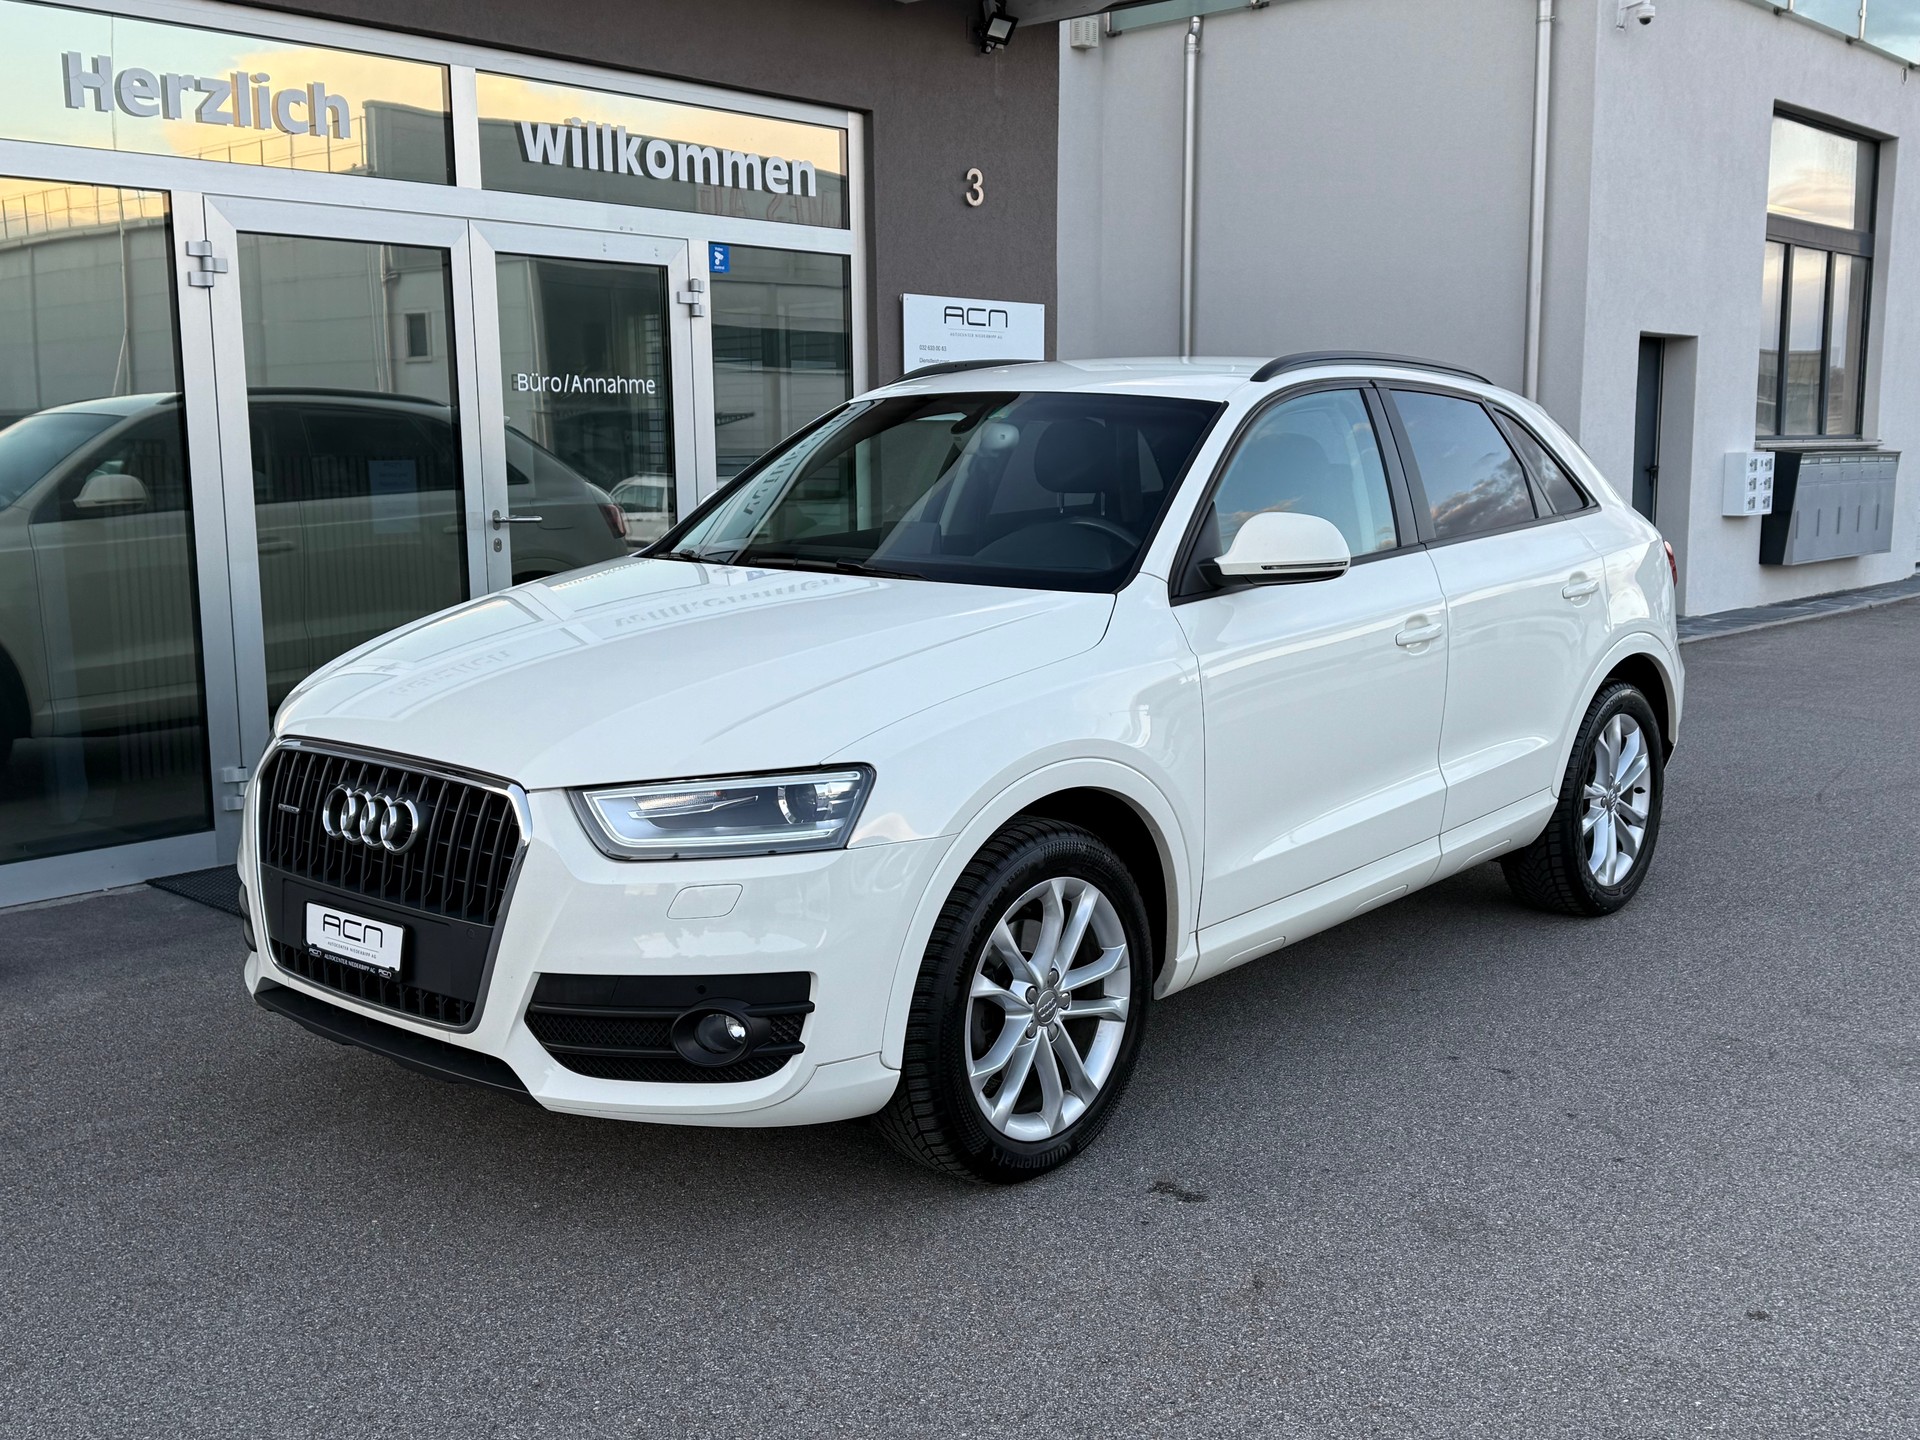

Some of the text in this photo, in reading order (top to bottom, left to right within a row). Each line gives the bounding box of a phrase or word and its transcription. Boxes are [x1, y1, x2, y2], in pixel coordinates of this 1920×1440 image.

[62, 51, 817, 197] Herzlich willkommen
[966, 167, 985, 207] 3
[944, 305, 1009, 328] ACN
[517, 373, 656, 394] Büro/Annahme
[323, 913, 384, 948] ACN
